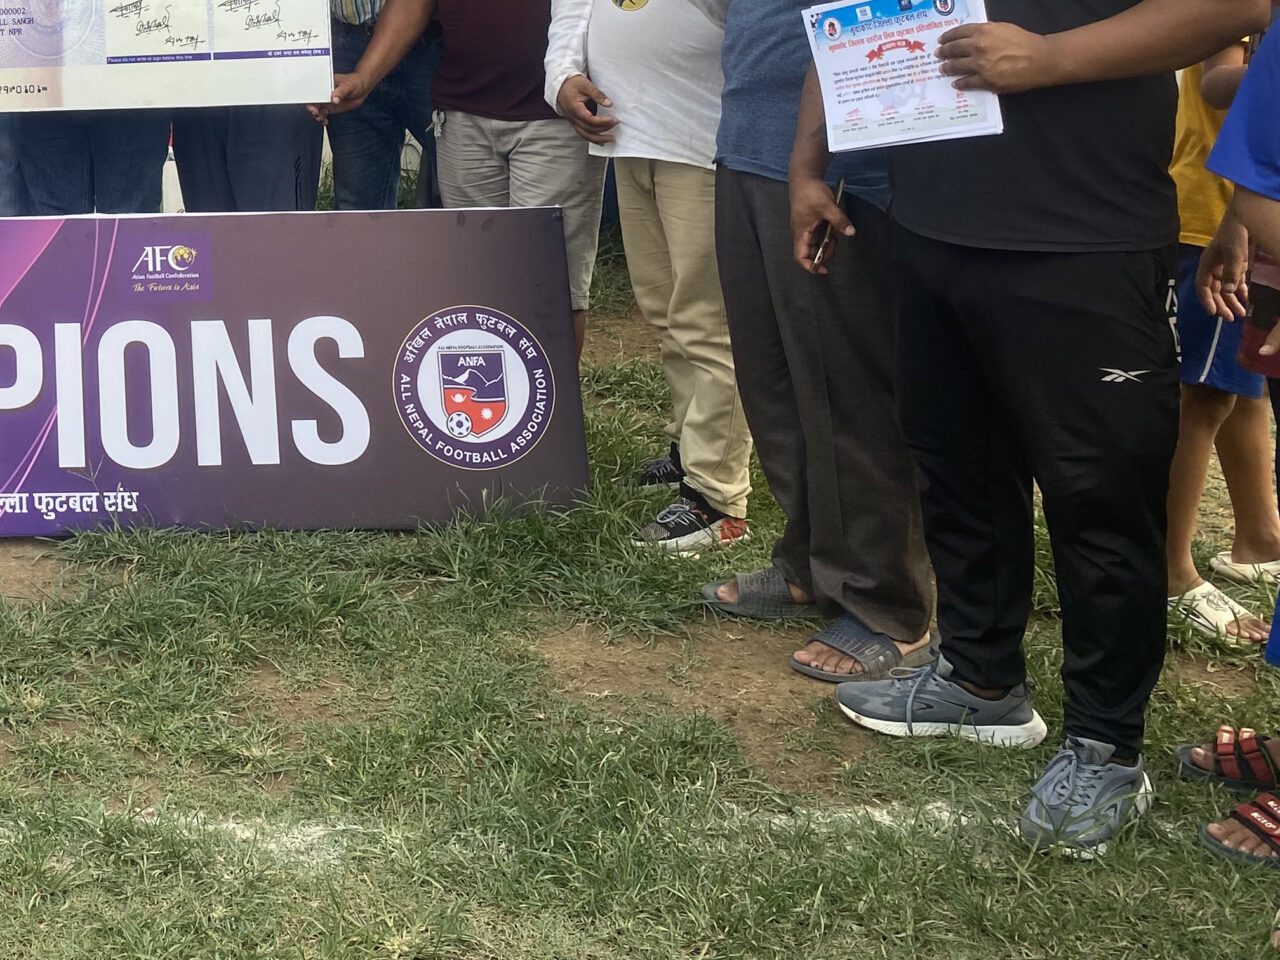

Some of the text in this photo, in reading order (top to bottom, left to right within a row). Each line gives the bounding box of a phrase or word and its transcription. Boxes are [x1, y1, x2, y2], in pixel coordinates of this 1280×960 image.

[12, 17, 35, 25] SANGH
[9, 28, 23, 36] NPR
[131, 245, 194, 273] AFC
[132, 281, 200, 292] The Future is Asia
[403, 312, 538, 363] अखिल नेपाल फुटबल संघ
[457, 356, 486, 367] ANFA
[400, 368, 547, 463] ALL NEPAL FOOTBALL ASSOCIATION
[32, 490, 100, 520] फुटबल
[103, 487, 140, 513] संघ
